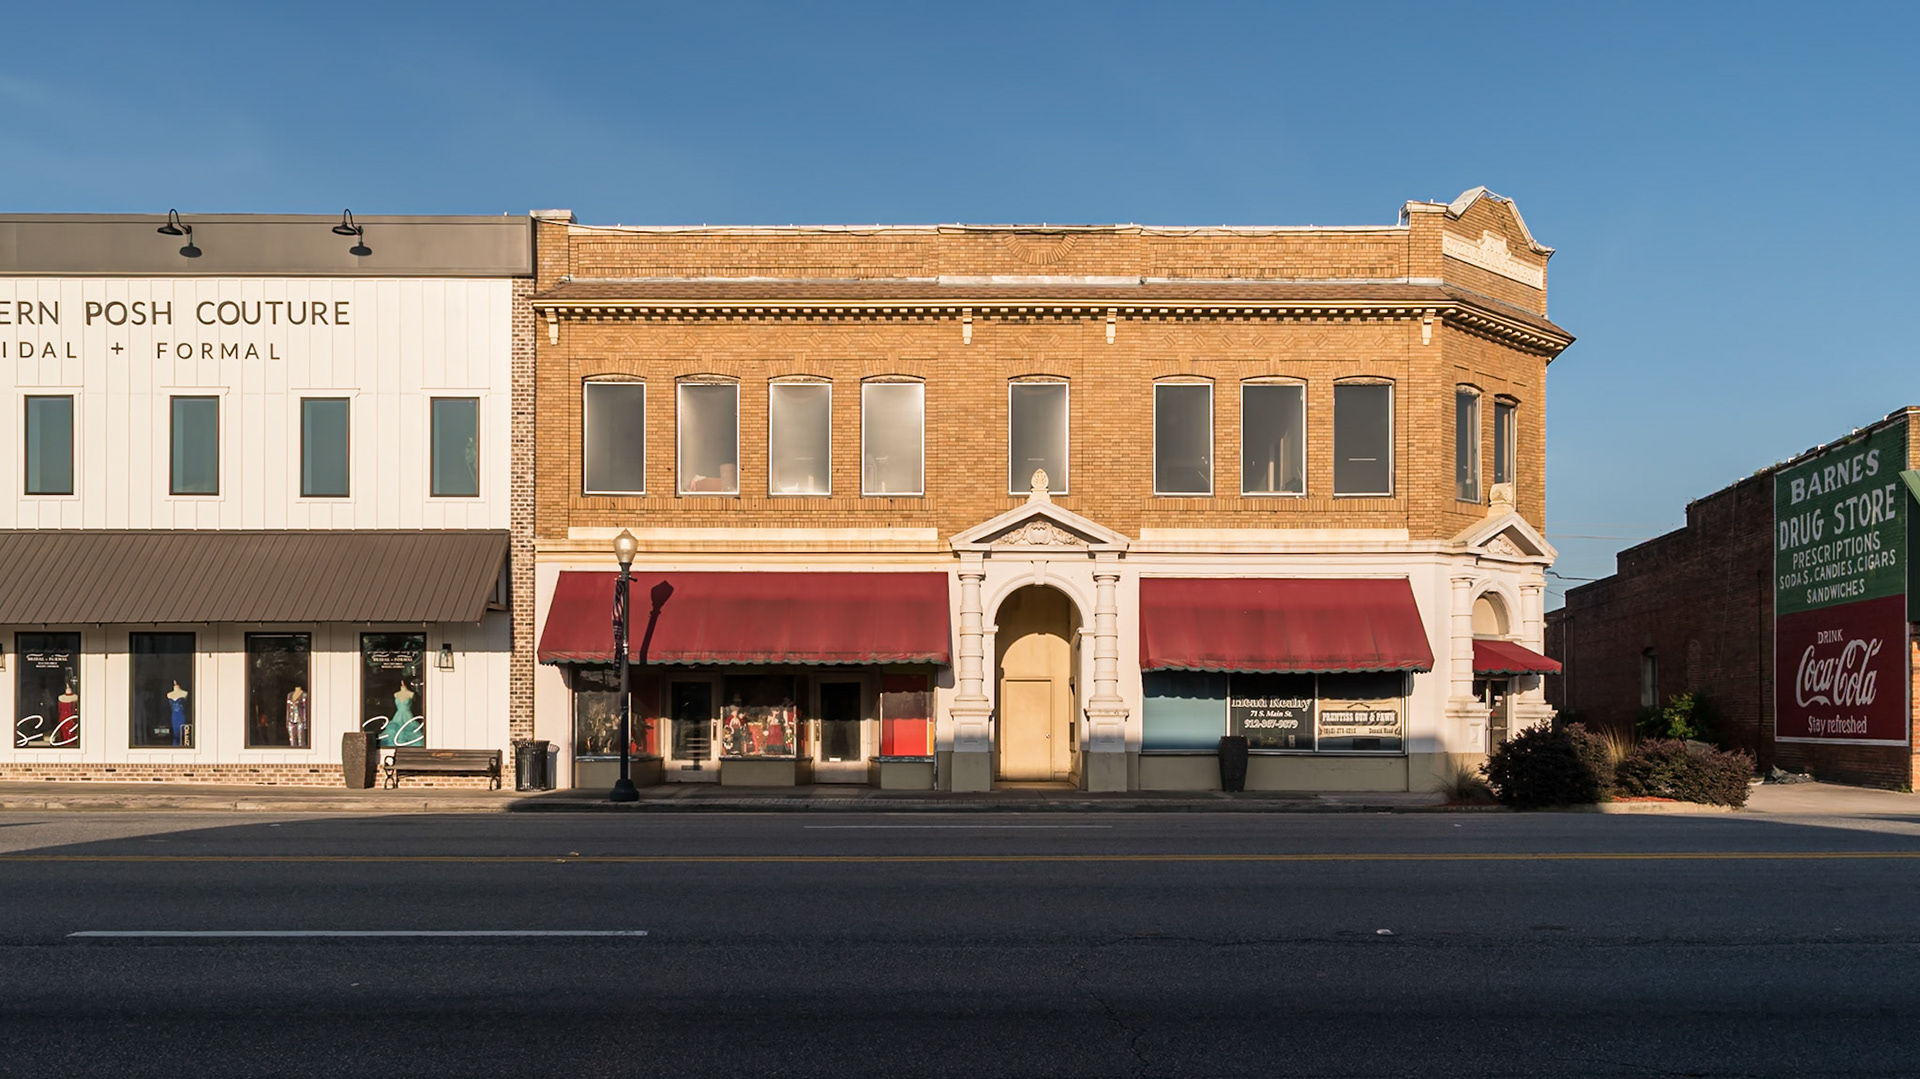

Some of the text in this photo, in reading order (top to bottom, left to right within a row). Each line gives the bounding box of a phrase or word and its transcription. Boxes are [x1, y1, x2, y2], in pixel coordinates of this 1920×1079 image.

[86, 300, 172, 326] POSH
[196, 300, 350, 326] COUTURE
[2, 341, 77, 359] IDAL
[157, 343, 281, 360] FORMAL
[1790, 449, 1880, 506] BARNES
[1780, 483, 1897, 551] DRUG STORE
[1793, 530, 1881, 570] PRESCRIPTIONS
[1857, 548, 1896, 573] CIGARS
[1806, 578, 1866, 604] SANDWICHES
[1817, 629, 1844, 644] DRINK
[1796, 638, 1883, 708] Coca-Cola
[1808, 714, 1867, 736] Stay refreshed
